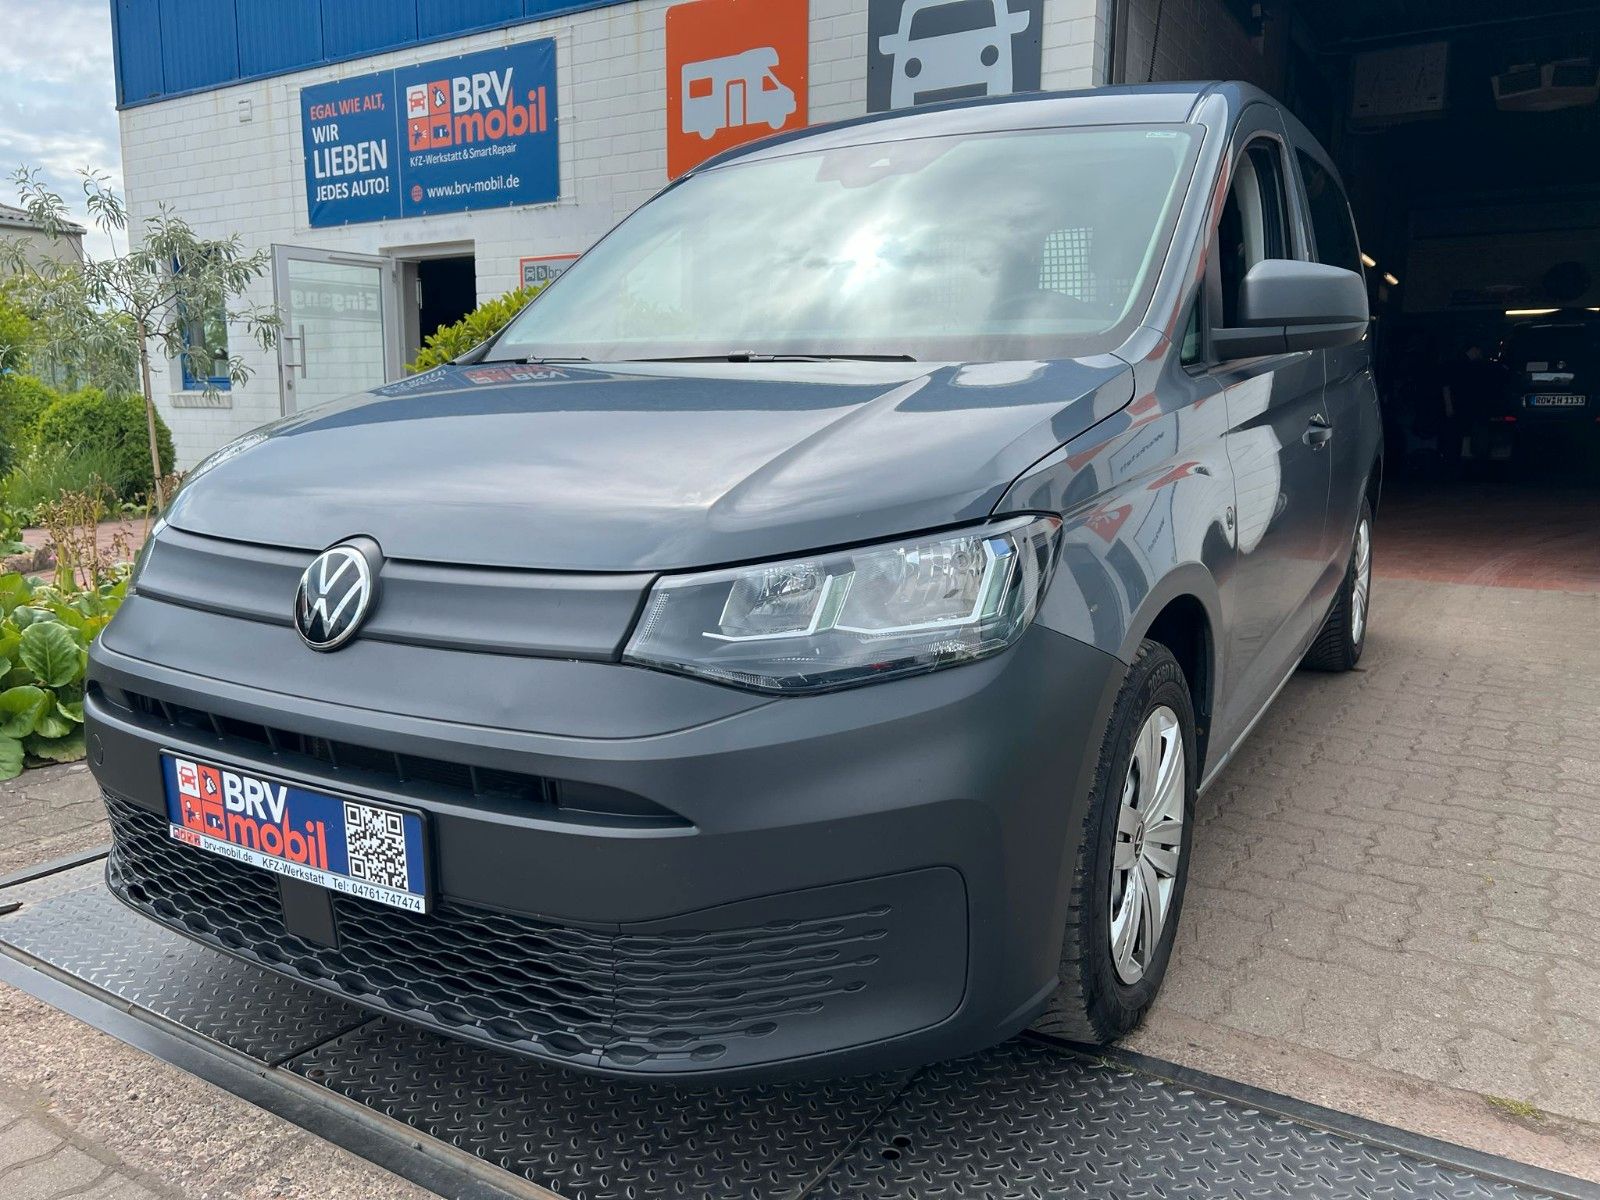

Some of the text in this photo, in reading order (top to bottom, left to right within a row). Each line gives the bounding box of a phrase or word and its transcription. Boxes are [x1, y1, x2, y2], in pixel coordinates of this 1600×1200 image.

[310, 93, 385, 120] EGAL WIE ALT,
[452, 67, 514, 114] BRV
[311, 123, 340, 144] WIR
[454, 85, 547, 145] mobil
[313, 138, 388, 179] LIEBEN
[316, 175, 390, 202] JEDES AUTO!
[427, 174, 520, 198] www.brv-mobil.de
[222, 771, 288, 824] BRV
[226, 808, 329, 870] mobil
[204, 839, 421, 910] brv-mobil.de KFZ-Werkstatt Tel: 04761-747474
